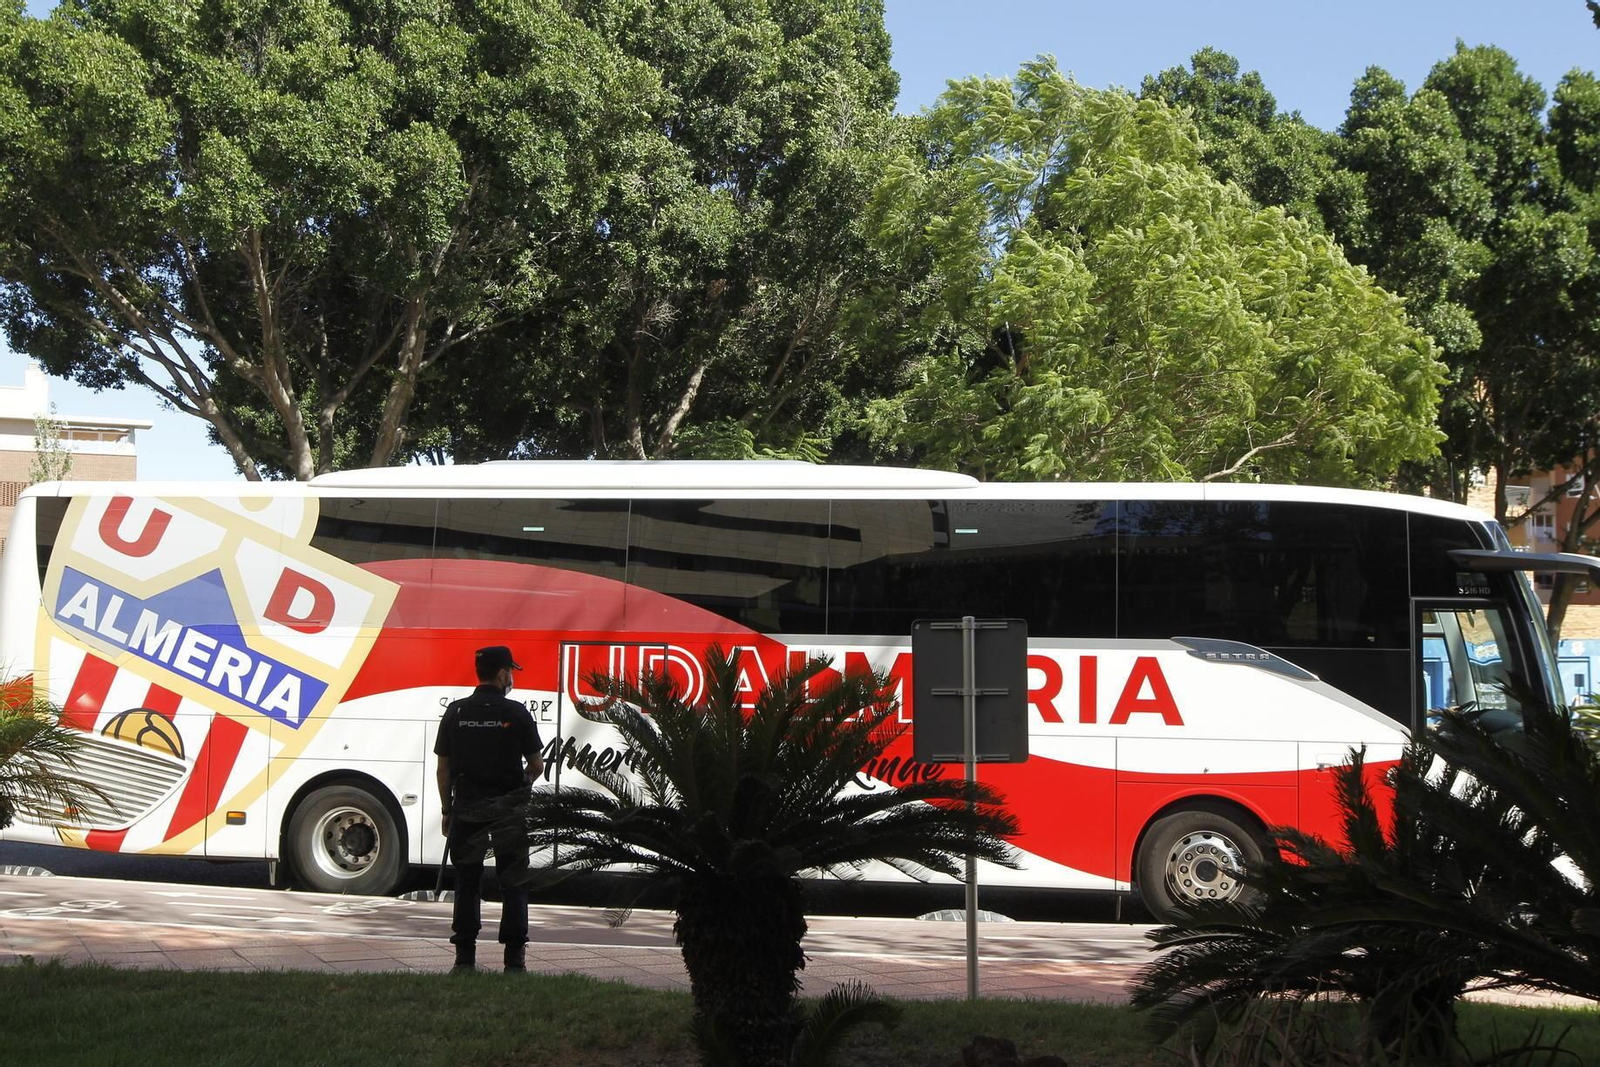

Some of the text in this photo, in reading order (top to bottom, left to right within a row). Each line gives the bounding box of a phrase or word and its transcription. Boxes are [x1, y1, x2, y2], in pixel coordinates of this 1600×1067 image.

[98, 496, 172, 557] U
[263, 567, 335, 633] D
[58, 582, 302, 724] ALMERIA
[563, 645, 1185, 726] UDALMRIA
[458, 720, 503, 728] POLICIA
[541, 736, 645, 782] Almeri
